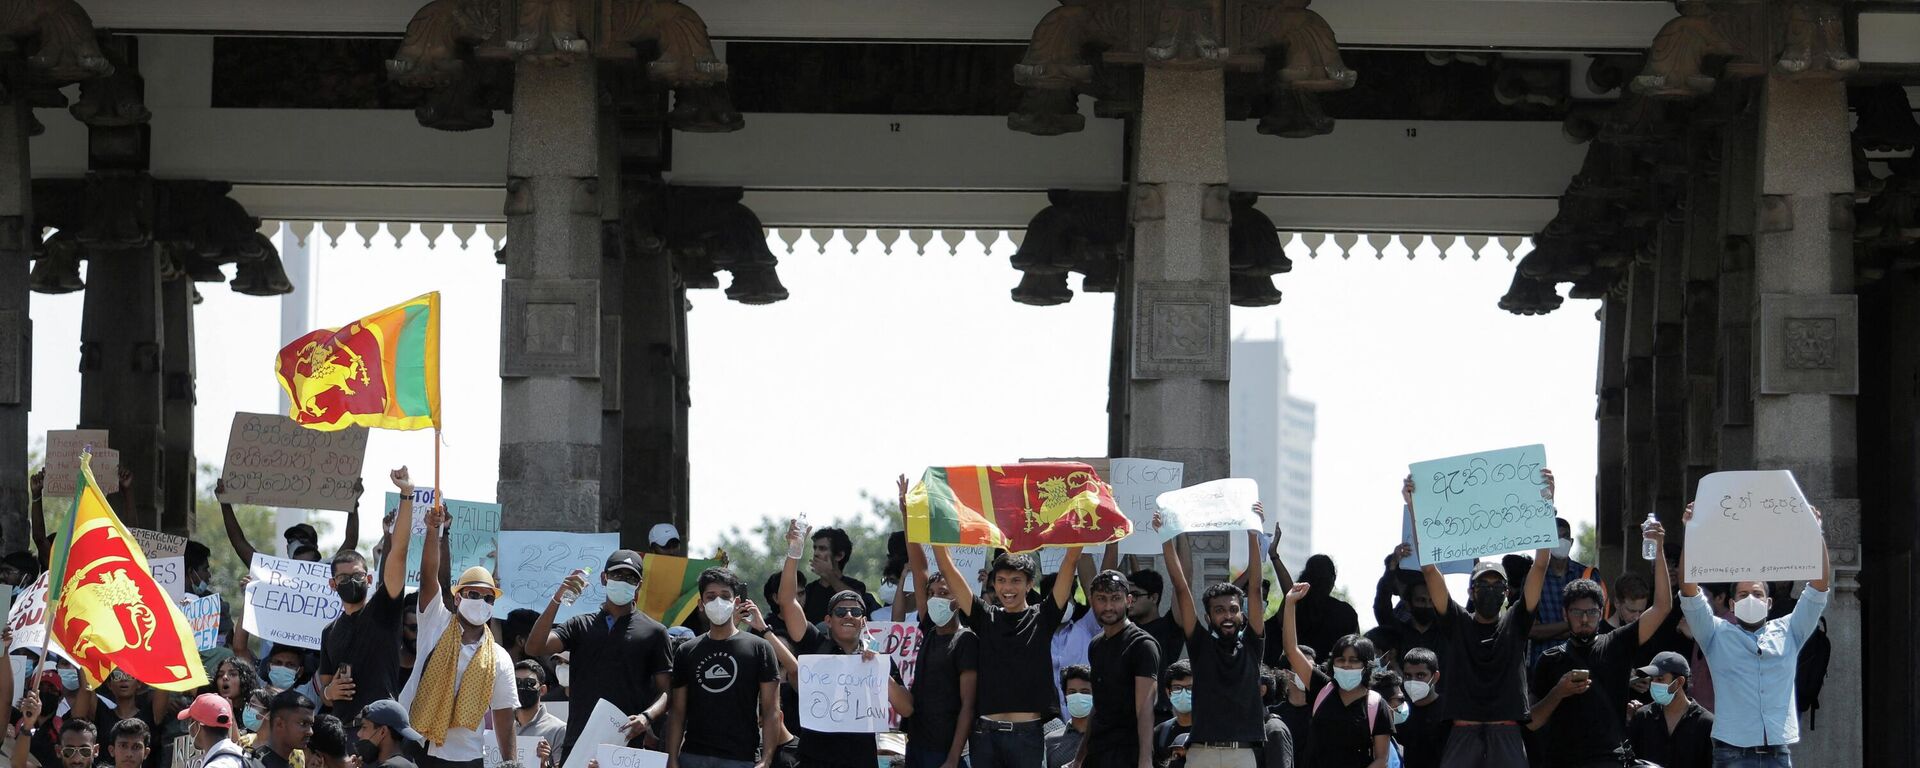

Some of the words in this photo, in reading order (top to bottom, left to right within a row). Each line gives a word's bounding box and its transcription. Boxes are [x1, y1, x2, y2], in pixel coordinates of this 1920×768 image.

[889, 122, 901, 133] 12
[1406, 127, 1417, 138] 13
[456, 505, 501, 534] FAILED
[131, 527, 187, 547] EMERGENCY
[156, 543, 179, 554] BANS
[517, 541, 605, 573] 225
[260, 557, 290, 572] WE
[800, 664, 831, 685] One
[855, 699, 886, 720] Law
